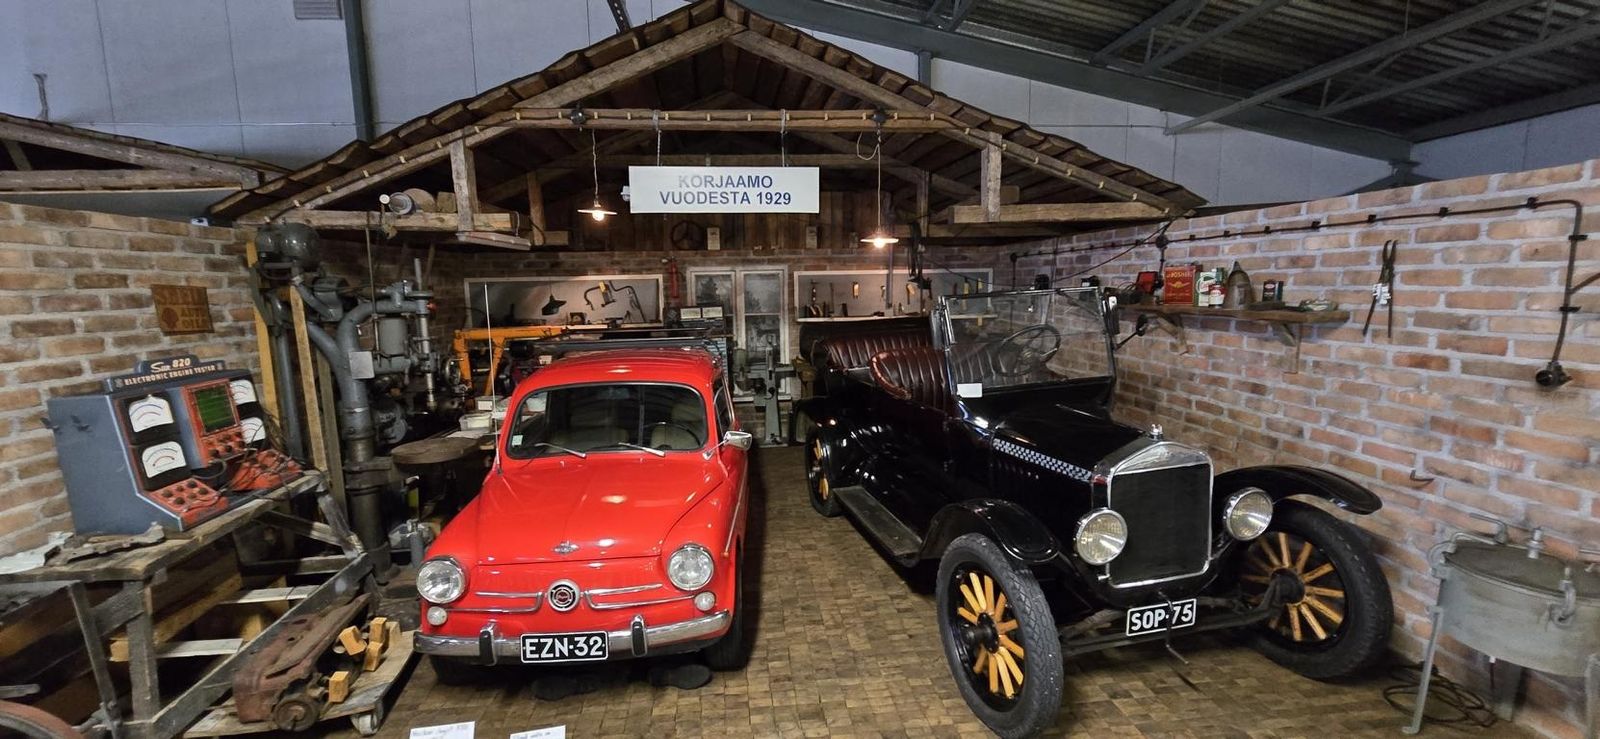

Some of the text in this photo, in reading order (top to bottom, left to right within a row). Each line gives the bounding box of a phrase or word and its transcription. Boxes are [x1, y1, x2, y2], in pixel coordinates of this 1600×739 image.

[678, 175, 773, 188] KORJAAMO
[660, 191, 791, 205] VUODESTA 1929
[172, 358, 190, 368] 820
[125, 365, 216, 385] ELECTRONIC ENGINE TESTER
